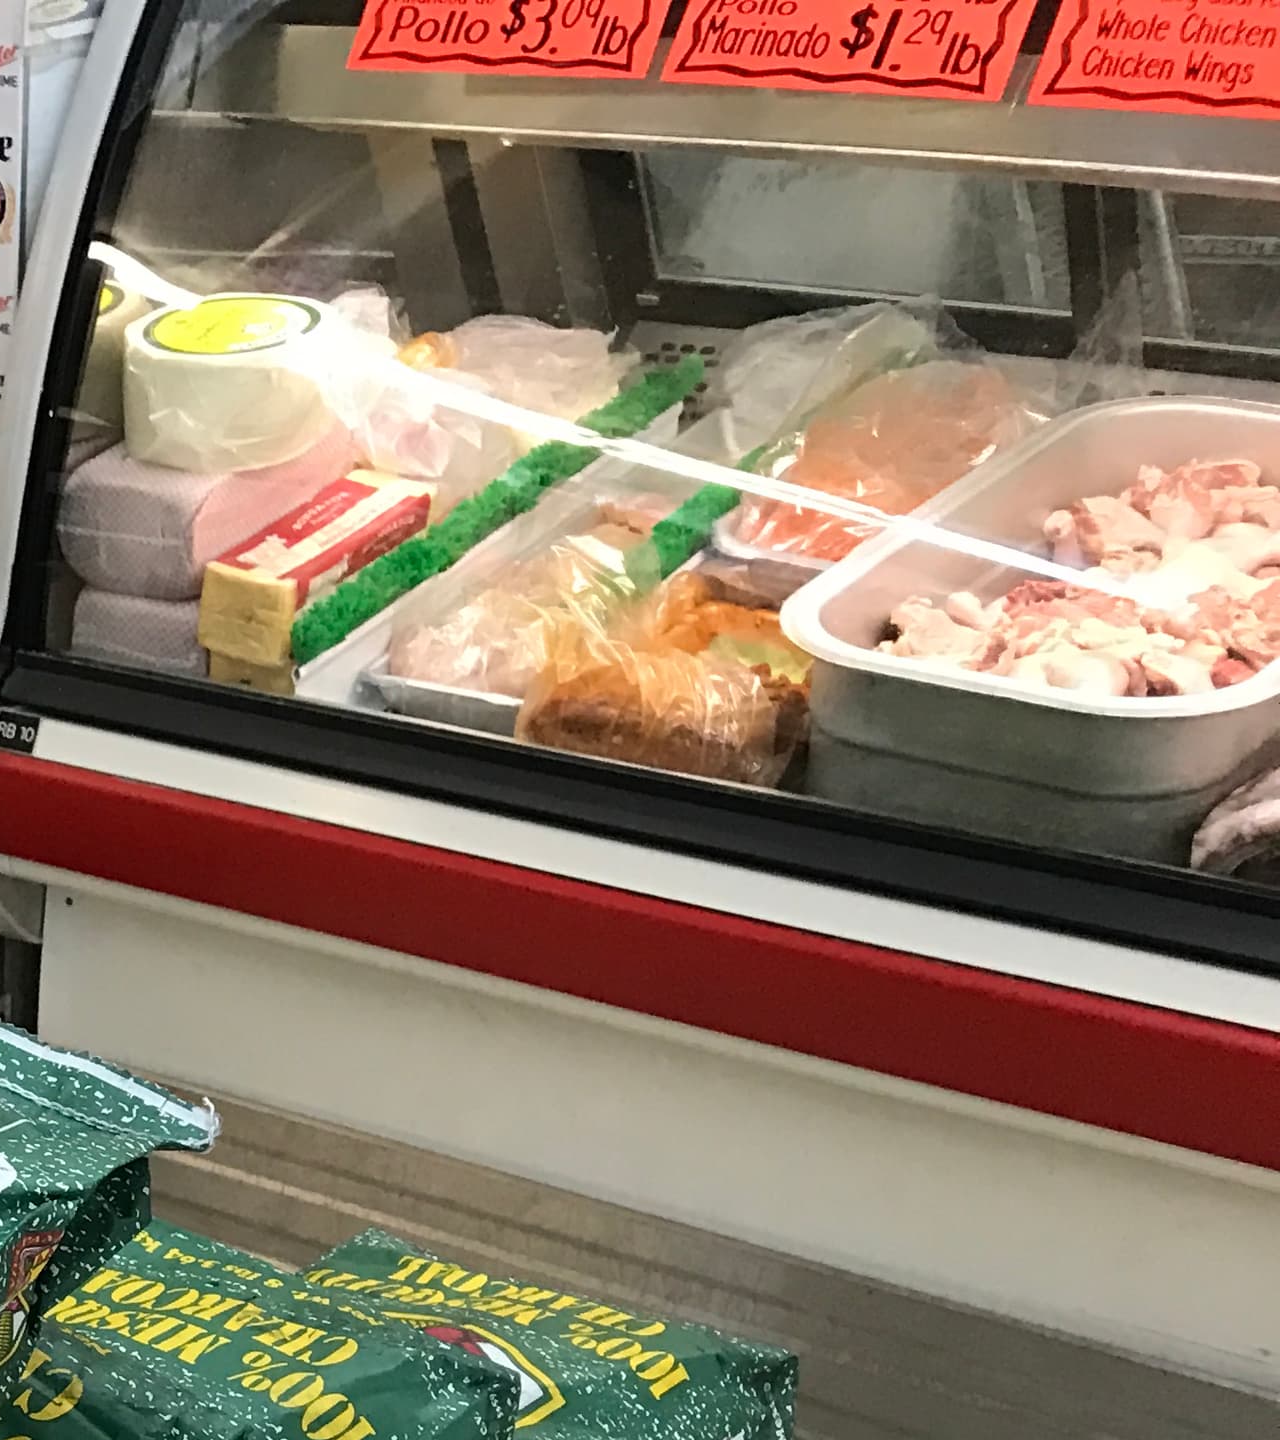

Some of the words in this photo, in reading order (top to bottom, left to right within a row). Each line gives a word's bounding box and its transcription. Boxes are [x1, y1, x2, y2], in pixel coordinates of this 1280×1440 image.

[389, 5, 489, 44] Pollo
[592, 16, 628, 56] lb
[699, 15, 830, 59] Marinado
[941, 32, 981, 75] lb
[1097, 9, 1170, 41] Whole
[1180, 13, 1276, 48] Chicken
[1083, 46, 1174, 80] Chicken
[1185, 52, 1254, 92] Wings
[20, 726, 35, 742] 10
[559, 1323, 690, 1401] 100%
